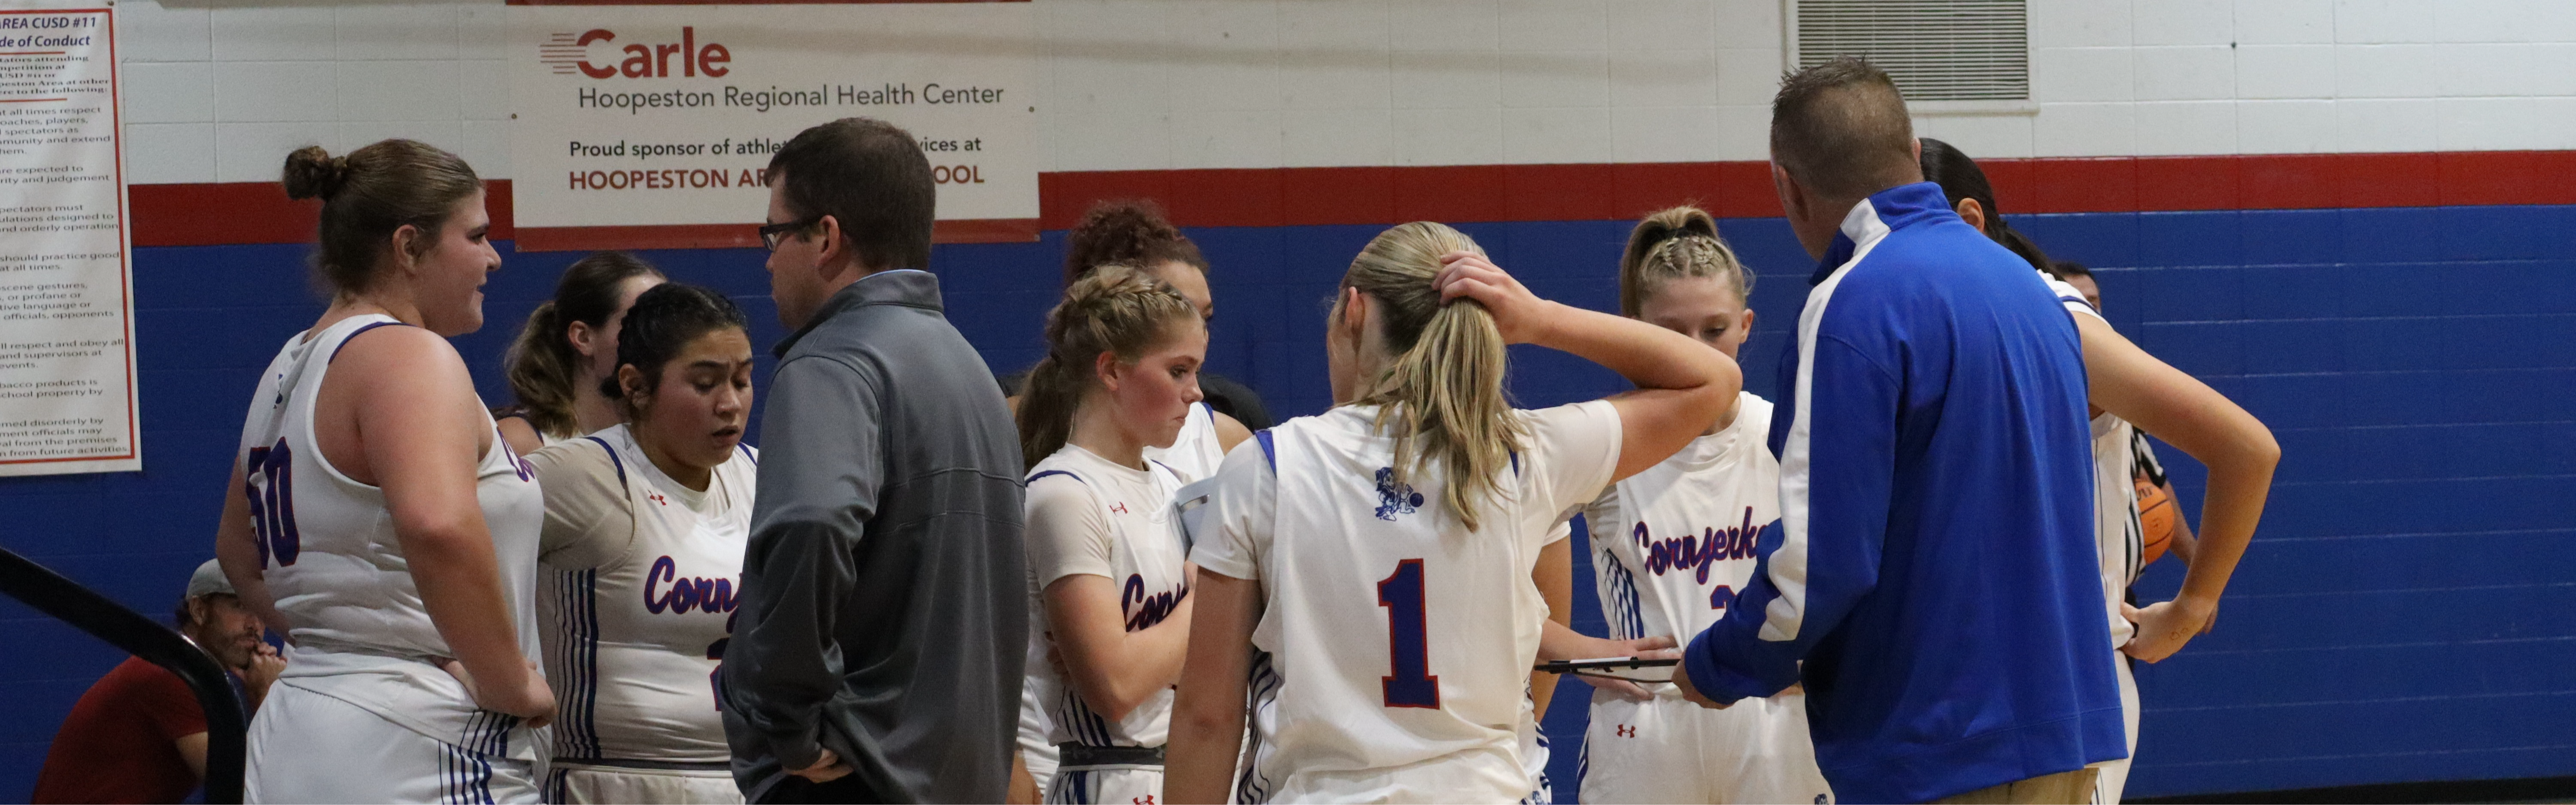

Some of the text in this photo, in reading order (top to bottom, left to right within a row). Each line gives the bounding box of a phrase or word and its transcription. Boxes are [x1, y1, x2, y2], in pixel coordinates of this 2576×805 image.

[0, 17, 96, 29] REA CUSD #11
[18, 35, 33, 47] of
[35, 35, 91, 46] Conduct
[576, 26, 731, 79] Carle
[579, 83, 1003, 114] Hoopeston Regional Health Center
[5, 128, 64, 136] spectators
[570, 141, 626, 157] Proud
[632, 145, 705, 160] sponsor
[711, 140, 730, 155] of
[964, 137, 981, 150] at
[16, 165, 68, 174] expected
[46, 174, 110, 184] judgement
[569, 170, 729, 189] HOOPESTON
[47, 213, 99, 222] designed
[64, 223, 118, 231] operation
[42, 252, 87, 261] practice
[90, 252, 119, 260] good
[24, 301, 76, 310] language
[52, 310, 114, 319] opponents
[24, 350, 88, 358] supervisors
[36, 380, 86, 389] products
[36, 390, 86, 398] property
[89, 388, 103, 396] by
[67, 437, 117, 445] premises
[1377, 558, 1440, 709] 1
